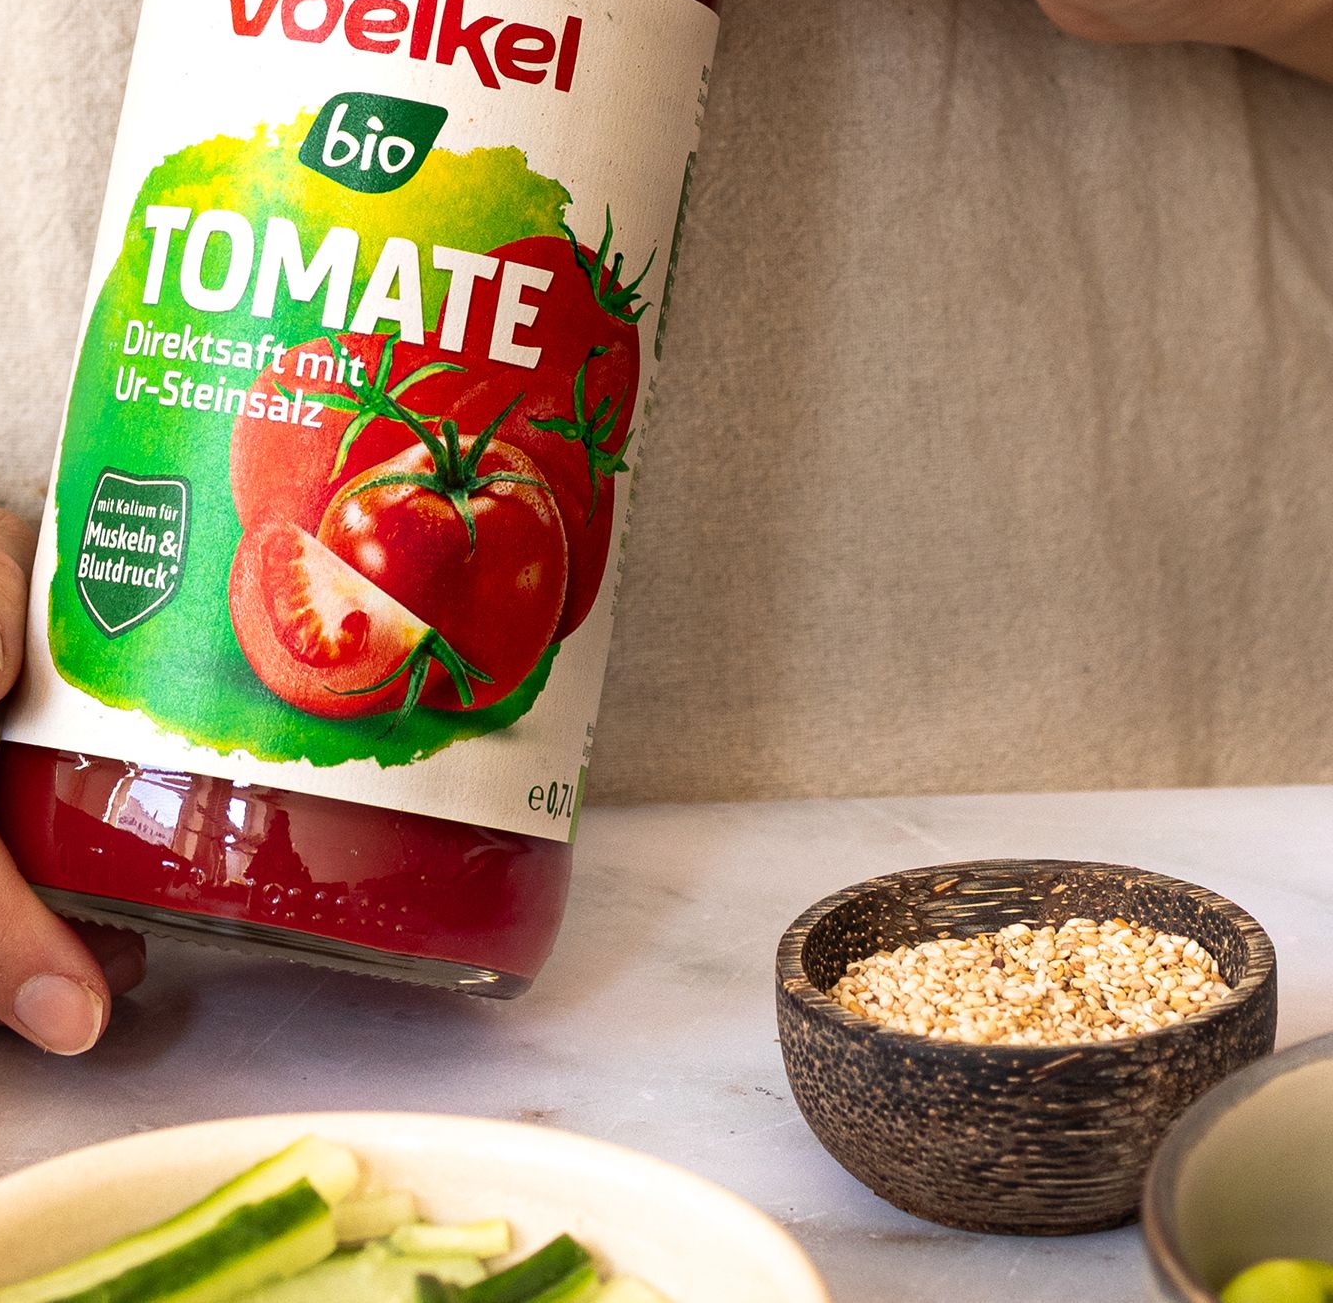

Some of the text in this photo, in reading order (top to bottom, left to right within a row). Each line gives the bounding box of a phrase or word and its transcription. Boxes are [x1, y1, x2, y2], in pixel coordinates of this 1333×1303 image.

[321, 102, 416, 174] bio
[137, 205, 554, 369] TOMATE
[122, 319, 365, 387] Direktsaft mit
[115, 365, 324, 429] Ur-Steinsalz
[87, 521, 179, 557] Muskeln &
[97, 498, 179, 522] mit Kalium für
